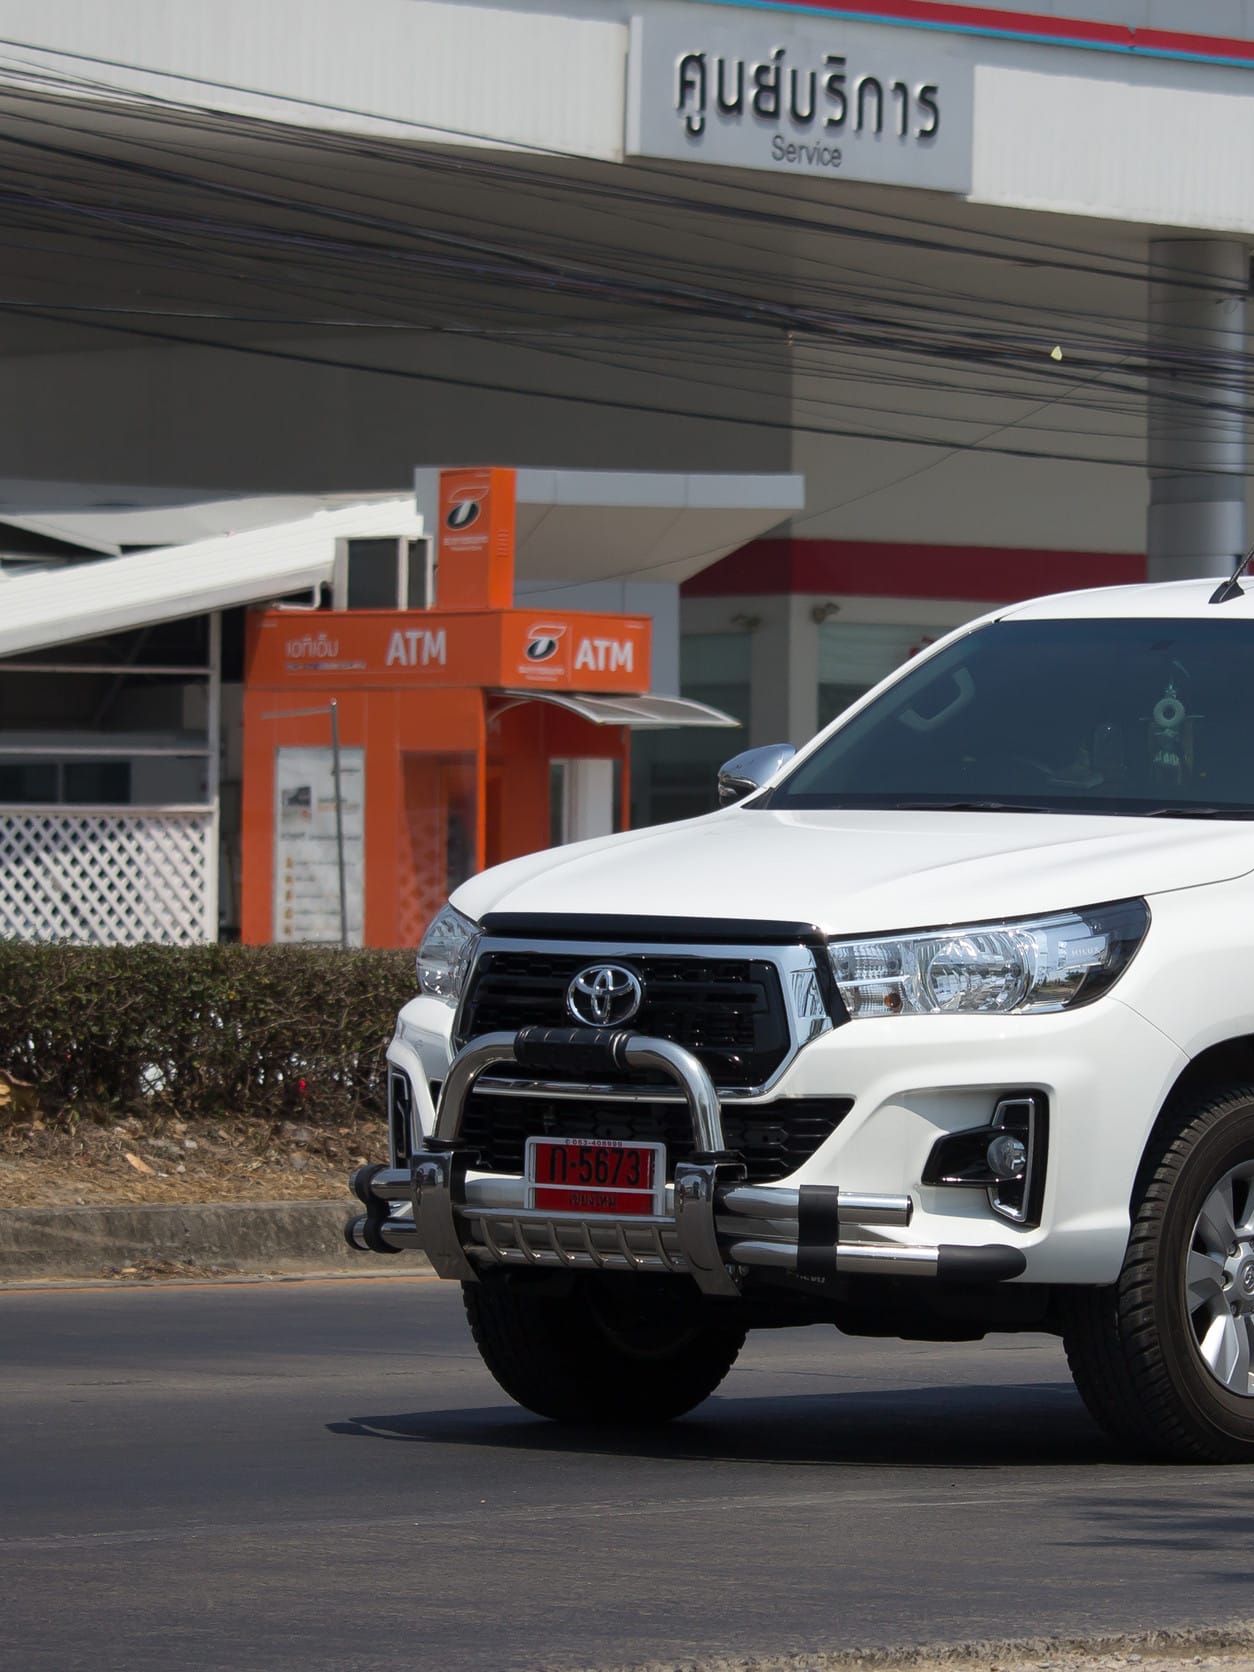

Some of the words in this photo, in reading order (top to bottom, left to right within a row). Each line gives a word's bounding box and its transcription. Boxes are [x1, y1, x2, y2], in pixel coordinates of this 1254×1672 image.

[676, 48, 939, 137] ศูนย์บริการ
[771, 135, 842, 168] Service
[385, 629, 447, 667] ATM
[574, 638, 634, 673] ATM
